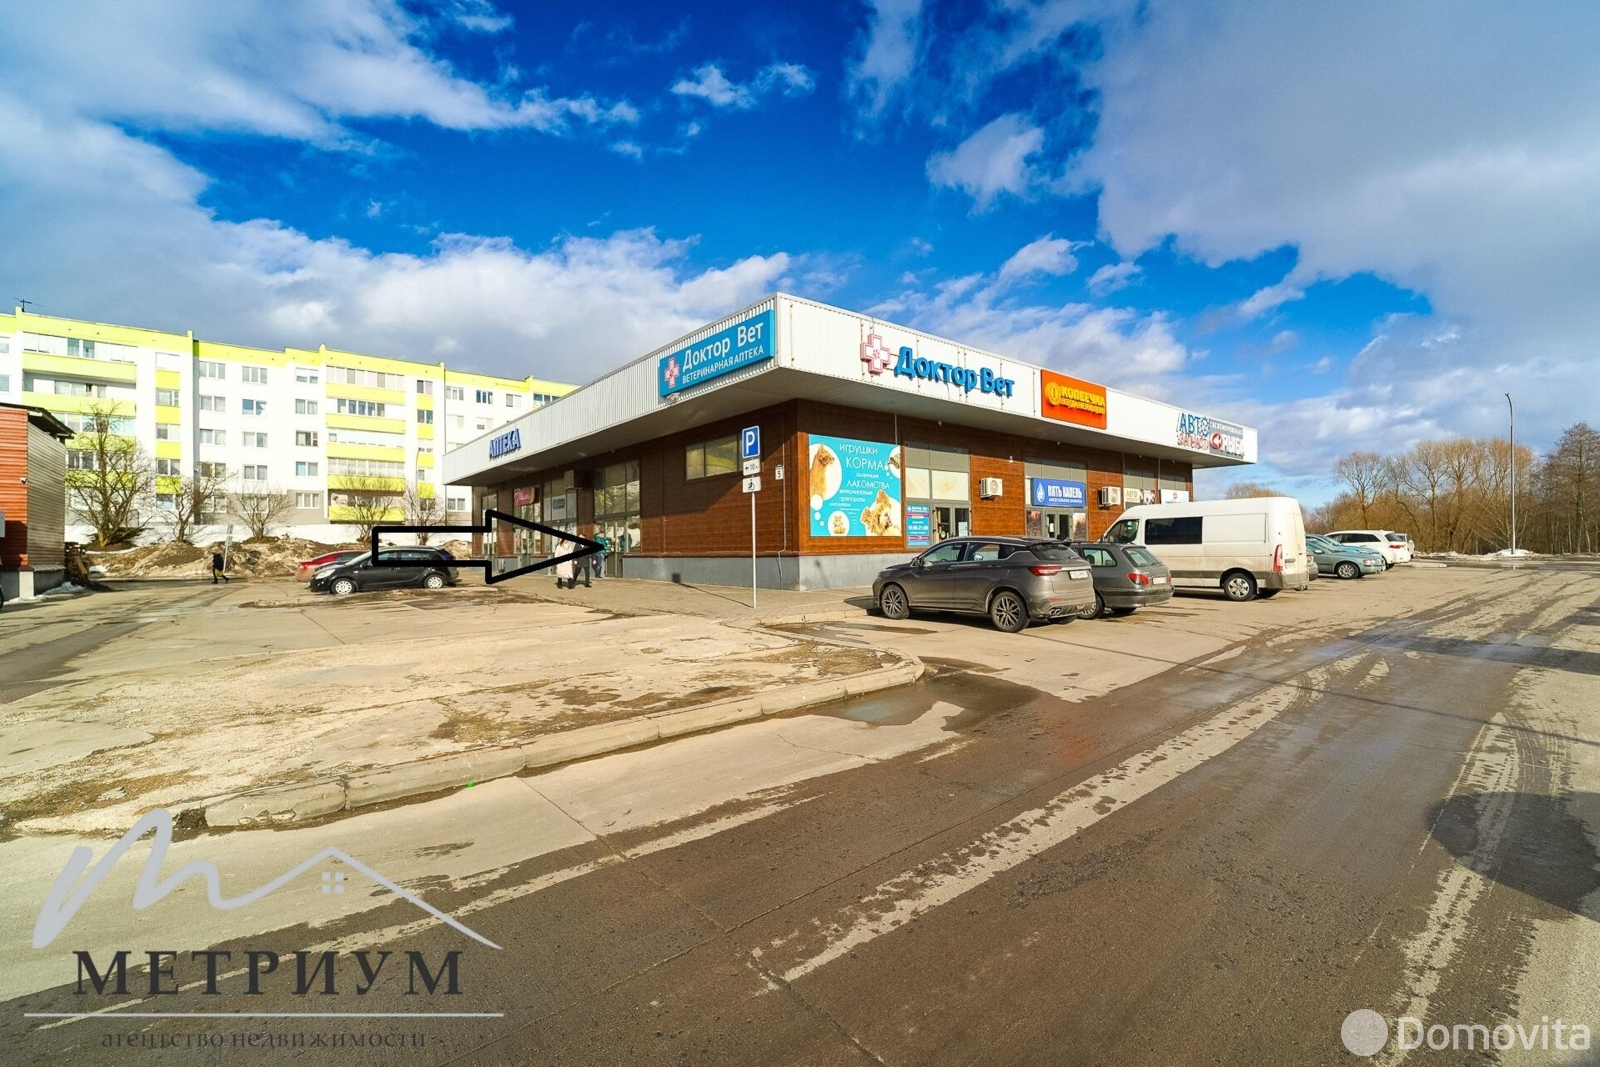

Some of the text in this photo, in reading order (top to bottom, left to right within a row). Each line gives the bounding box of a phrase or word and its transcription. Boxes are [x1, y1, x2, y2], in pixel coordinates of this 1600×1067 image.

[682, 322, 764, 372] Доктор Вет
[682, 345, 764, 384] ВЕТЕРИНАРНАЯ АПТЕКА
[894, 346, 1015, 397] Доктор Вет
[1060, 385, 1105, 407] КОПЕЕЧКА
[1178, 411, 1210, 437] АВТО
[489, 428, 521, 460] АПТЕКА
[846, 456, 884, 471] КОРМА
[847, 480, 890, 490] ЛАКОМСТВА
[1047, 485, 1083, 499] ПЯТЬ КАПЕЛЬ
